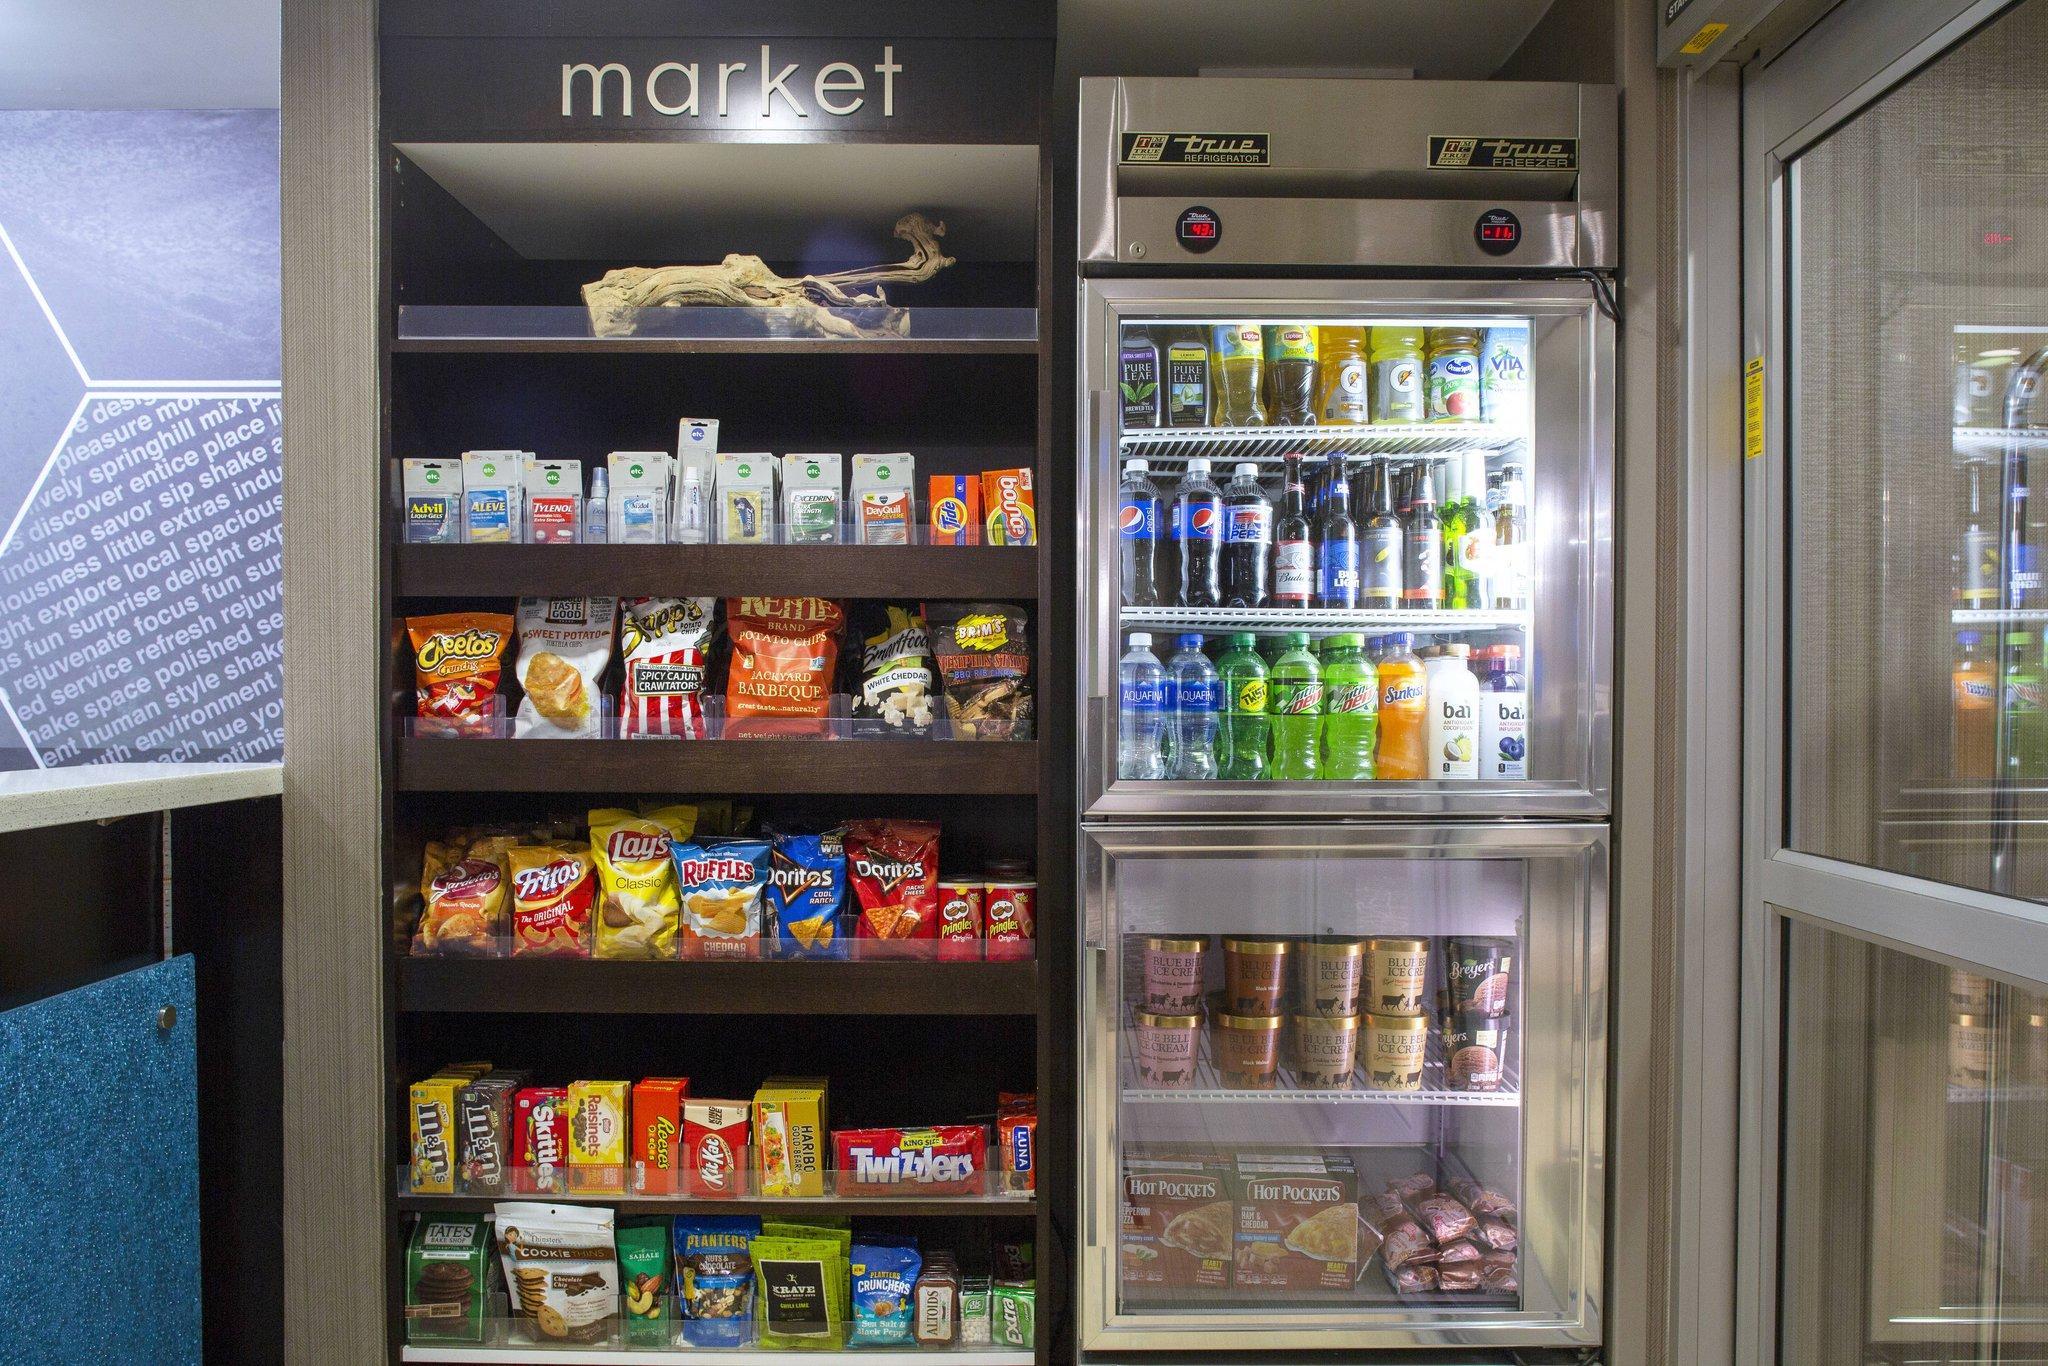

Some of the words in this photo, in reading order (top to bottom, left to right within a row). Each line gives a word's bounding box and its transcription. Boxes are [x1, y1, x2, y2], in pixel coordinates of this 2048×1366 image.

[562, 45, 903, 117] market
[1173, 135, 1260, 153] true
[1482, 140, 1569, 158] true
[1184, 154, 1260, 163] REFRIGERATOR
[1493, 158, 1569, 168] FREEZER
[1243, 331, 1260, 340] Lipton
[1284, 332, 1304, 340] Lipton
[1124, 362, 1152, 373] PURE
[1173, 365, 1203, 374] PURE
[1490, 356, 1524, 371] VITA
[1124, 371, 1153, 381] LEAF
[1173, 374, 1201, 383] LEAF
[56, 414, 154, 477] pleasure
[88, 417, 197, 484] springhill
[199, 400, 243, 432] mix
[28, 484, 124, 542] discover
[129, 449, 200, 493] entice
[202, 417, 266, 464] place
[410, 503, 445, 514] Advil
[471, 501, 506, 512] ALEVE
[533, 502, 573, 513] TYLENOL
[866, 505, 901, 518] DayQuil
[998, 476, 1026, 539] bounce
[0, 533, 88, 585] indulge
[90, 499, 153, 542] savor
[158, 481, 194, 505] sip
[198, 446, 268, 490] shake
[939, 500, 962, 530] Tide
[103, 529, 157, 564] little
[159, 493, 231, 537] extras
[38, 574, 122, 625] explore
[123, 541, 181, 583] local
[24, 631, 65, 660] fun
[67, 585, 161, 640] surprise
[165, 541, 245, 592] delight
[553, 602, 581, 610] TASTE
[552, 610, 580, 619] GOOD
[680, 621, 702, 629] POTATO
[767, 622, 806, 632] BRAND
[958, 619, 1003, 639] BRIM'S
[13, 627, 133, 695] rejuvenate
[133, 595, 199, 637] focus
[201, 575, 242, 603] fun
[528, 629, 561, 639] SWEET
[563, 630, 601, 640] POTATO
[738, 630, 790, 645] POTATO
[793, 631, 827, 647] CHIPS
[417, 632, 499, 669] Cheetos
[50, 656, 133, 706] service
[136, 614, 218, 666] refresh
[83, 676, 152, 719] space
[154, 622, 253, 691] polished
[641, 671, 664, 681] SPICY
[666, 671, 698, 681] CAJUN
[953, 670, 971, 680] BBQ
[639, 681, 699, 691] CRAWTATORS
[867, 677, 890, 691] WHITE
[891, 672, 928, 681] CHEDDAR
[737, 681, 823, 701] BARBEQUE
[1122, 690, 1164, 703] AQUAFINA
[1176, 690, 1217, 703] AQUAFINA
[1384, 685, 1423, 704] Sunkist
[81, 701, 161, 749] human
[164, 673, 220, 709] style
[135, 671, 278, 752] environment
[201, 717, 248, 749] hue
[612, 832, 671, 863] Lay's
[683, 859, 755, 887] RUFFLES
[856, 860, 924, 877] Doritos
[514, 860, 582, 899] Fritos
[615, 876, 663, 890] Classic
[767, 867, 832, 887] Doritos
[533, 900, 574, 922] ORIGINAL
[941, 918, 973, 940] Pringles
[989, 918, 1018, 940] Pringles
[951, 934, 973, 943] Original
[997, 934, 1020, 943] Original
[703, 941, 747, 952] CHEDDAR
[1152, 956, 1182, 968] BLUE
[1320, 961, 1349, 971] BLUE
[1388, 957, 1413, 968] BLUE
[1152, 965, 1169, 976] ICE
[1321, 971, 1338, 980] ICE
[1387, 967, 1406, 977] ICE
[1449, 960, 1495, 980] Breyers
[1163, 1032, 1190, 1043] BELL
[1303, 1034, 1332, 1044] BLUE
[1377, 1033, 1408, 1045] BLUE
[1151, 1043, 1190, 1053] CREAM
[1303, 1044, 1320, 1054] ICE
[1377, 1044, 1395, 1053] ICE
[708, 1106, 716, 1124] KING
[587, 1093, 602, 1158] Raisinets
[532, 1105, 558, 1190] Skittles
[656, 1115, 676, 1172] Reese's
[801, 1125, 816, 1174] HARIBO
[903, 1138, 924, 1147] KING
[1016, 1130, 1030, 1168] LUNA
[850, 1146, 975, 1183] Twizzlers
[1130, 1179, 1158, 1196] HOT
[1158, 1179, 1217, 1199] POCKETS
[1253, 1184, 1281, 1200] HOT
[1281, 1184, 1341, 1202] POCKETS
[1241, 1211, 1256, 1220] HAM
[429, 1224, 473, 1238] TATE'S
[1241, 1219, 1269, 1230] CHEDDAR
[686, 1234, 748, 1250] PLANTERS
[520, 1248, 571, 1258] COOKIE
[572, 1250, 605, 1258] THINS
[628, 1251, 660, 1260] SAHALE
[705, 1254, 722, 1262] NUTS
[553, 1275, 583, 1283] Chocolate
[553, 1281, 568, 1290] Chip
[771, 1285, 816, 1296] KRAVE
[857, 1280, 911, 1295] CRUNCHERS
[926, 1290, 939, 1336] ALTOIDS
[861, 1320, 877, 1328] Sea
[879, 1320, 898, 1328] Salt
[1003, 1297, 1024, 1345] Extra
